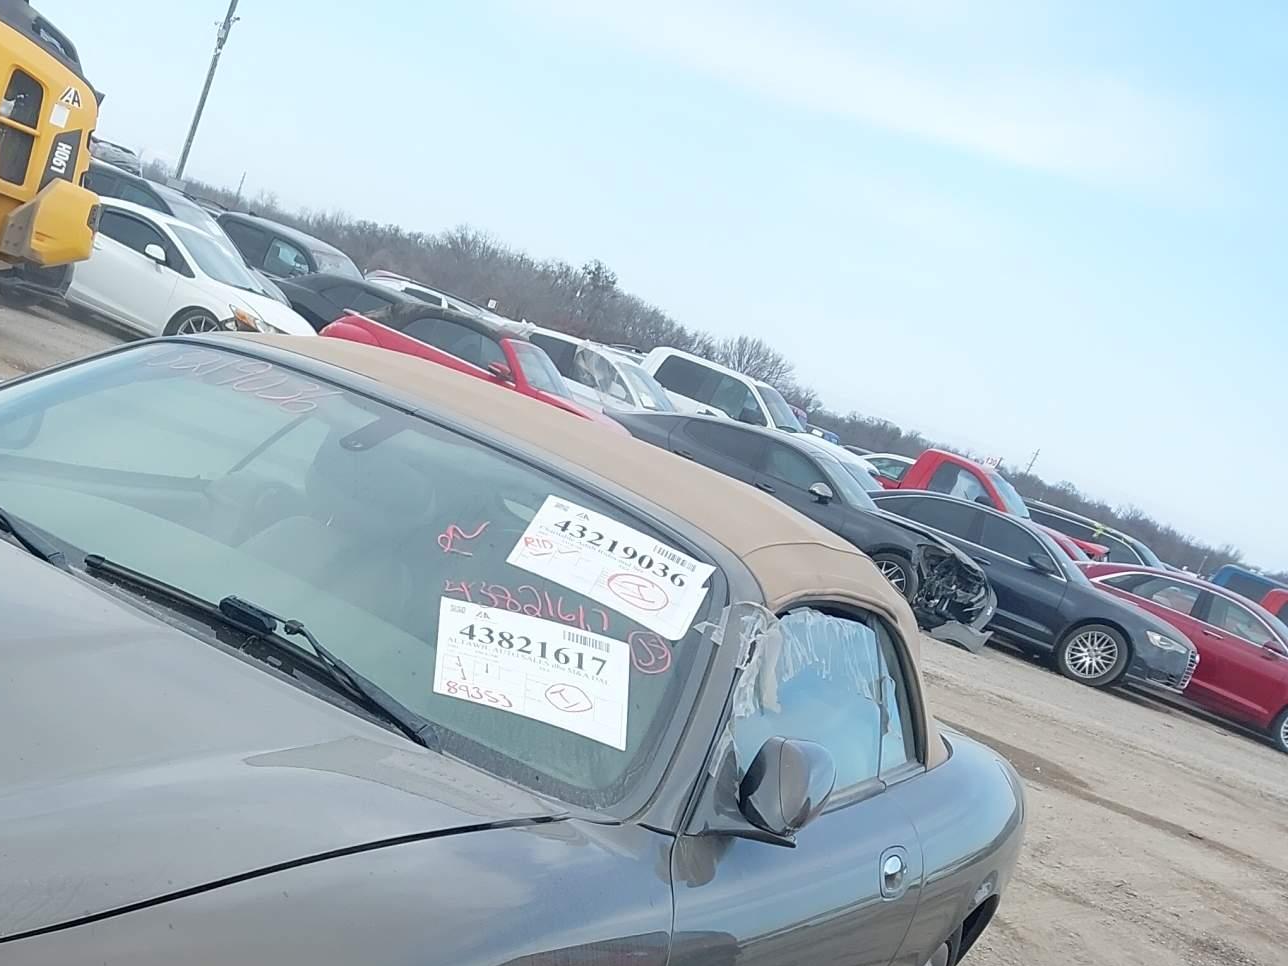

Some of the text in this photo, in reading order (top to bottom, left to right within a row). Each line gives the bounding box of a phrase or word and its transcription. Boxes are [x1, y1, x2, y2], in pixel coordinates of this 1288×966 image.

[50, 142, 73, 174] L90H
[554, 520, 688, 587] 43219036
[459, 623, 608, 676] 43821617
